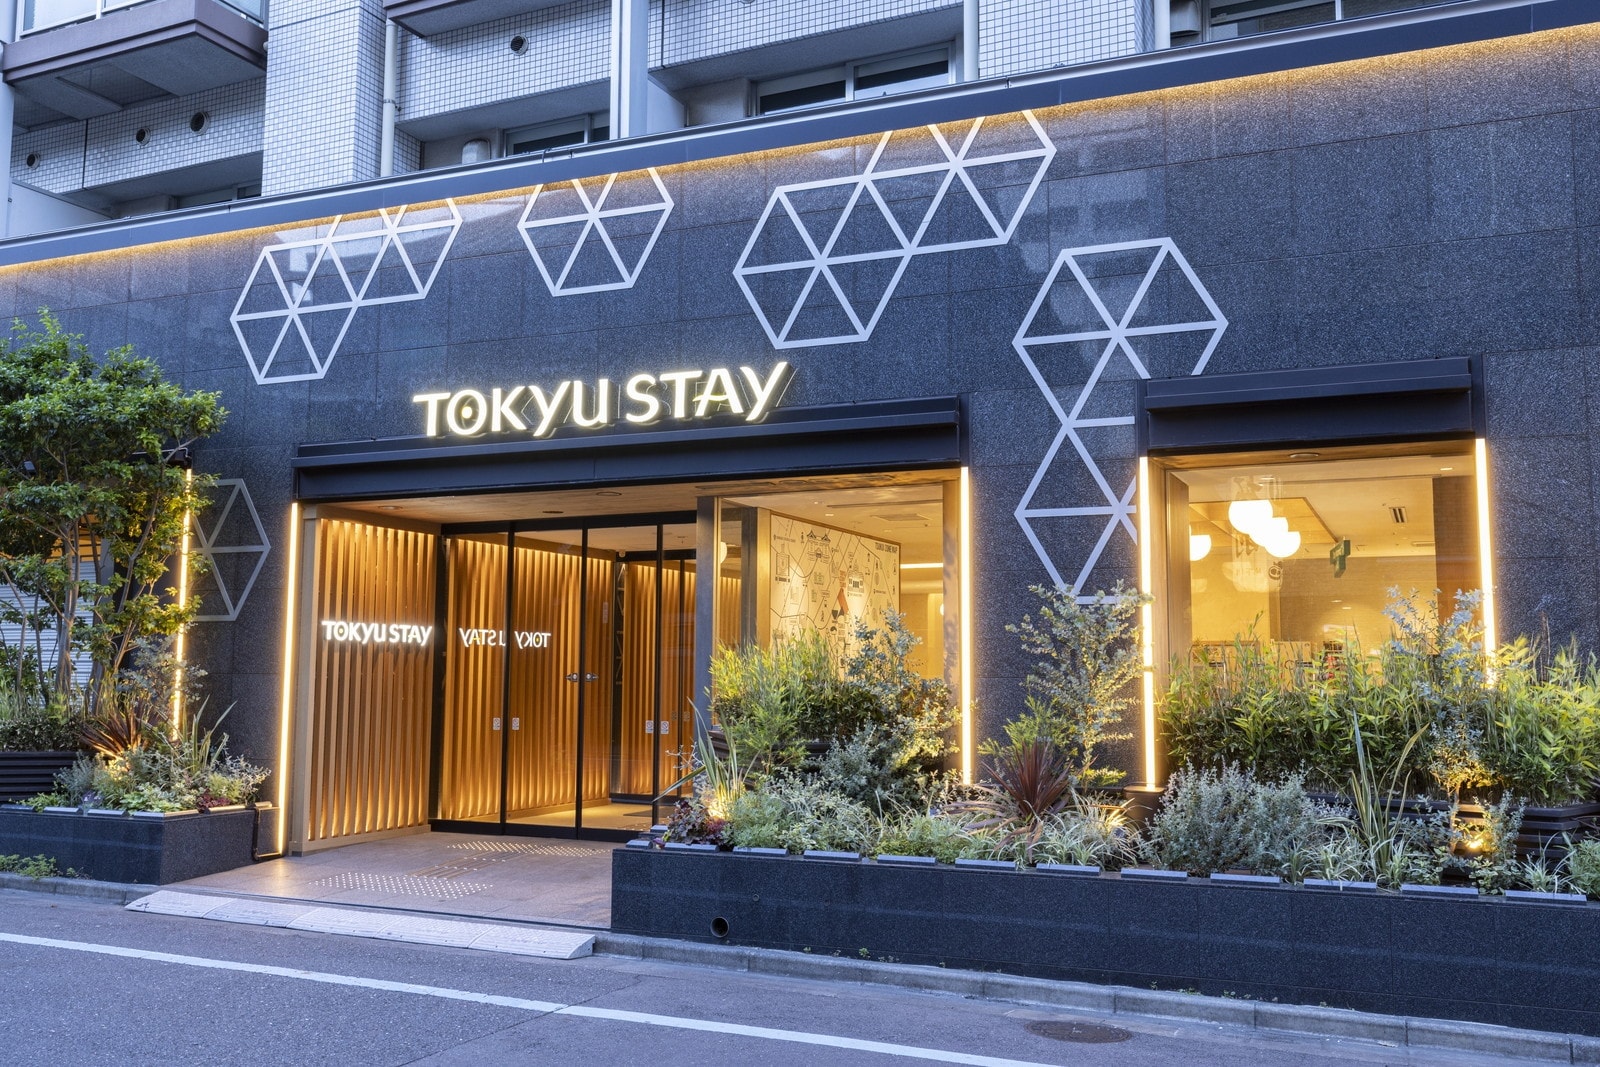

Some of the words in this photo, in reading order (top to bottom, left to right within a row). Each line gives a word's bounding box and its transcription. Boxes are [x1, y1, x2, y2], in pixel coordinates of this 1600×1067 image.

[413, 380, 609, 437] TOKYU
[626, 362, 788, 422] STAY
[322, 621, 386, 644] TOKYU
[388, 624, 432, 646] STAY
